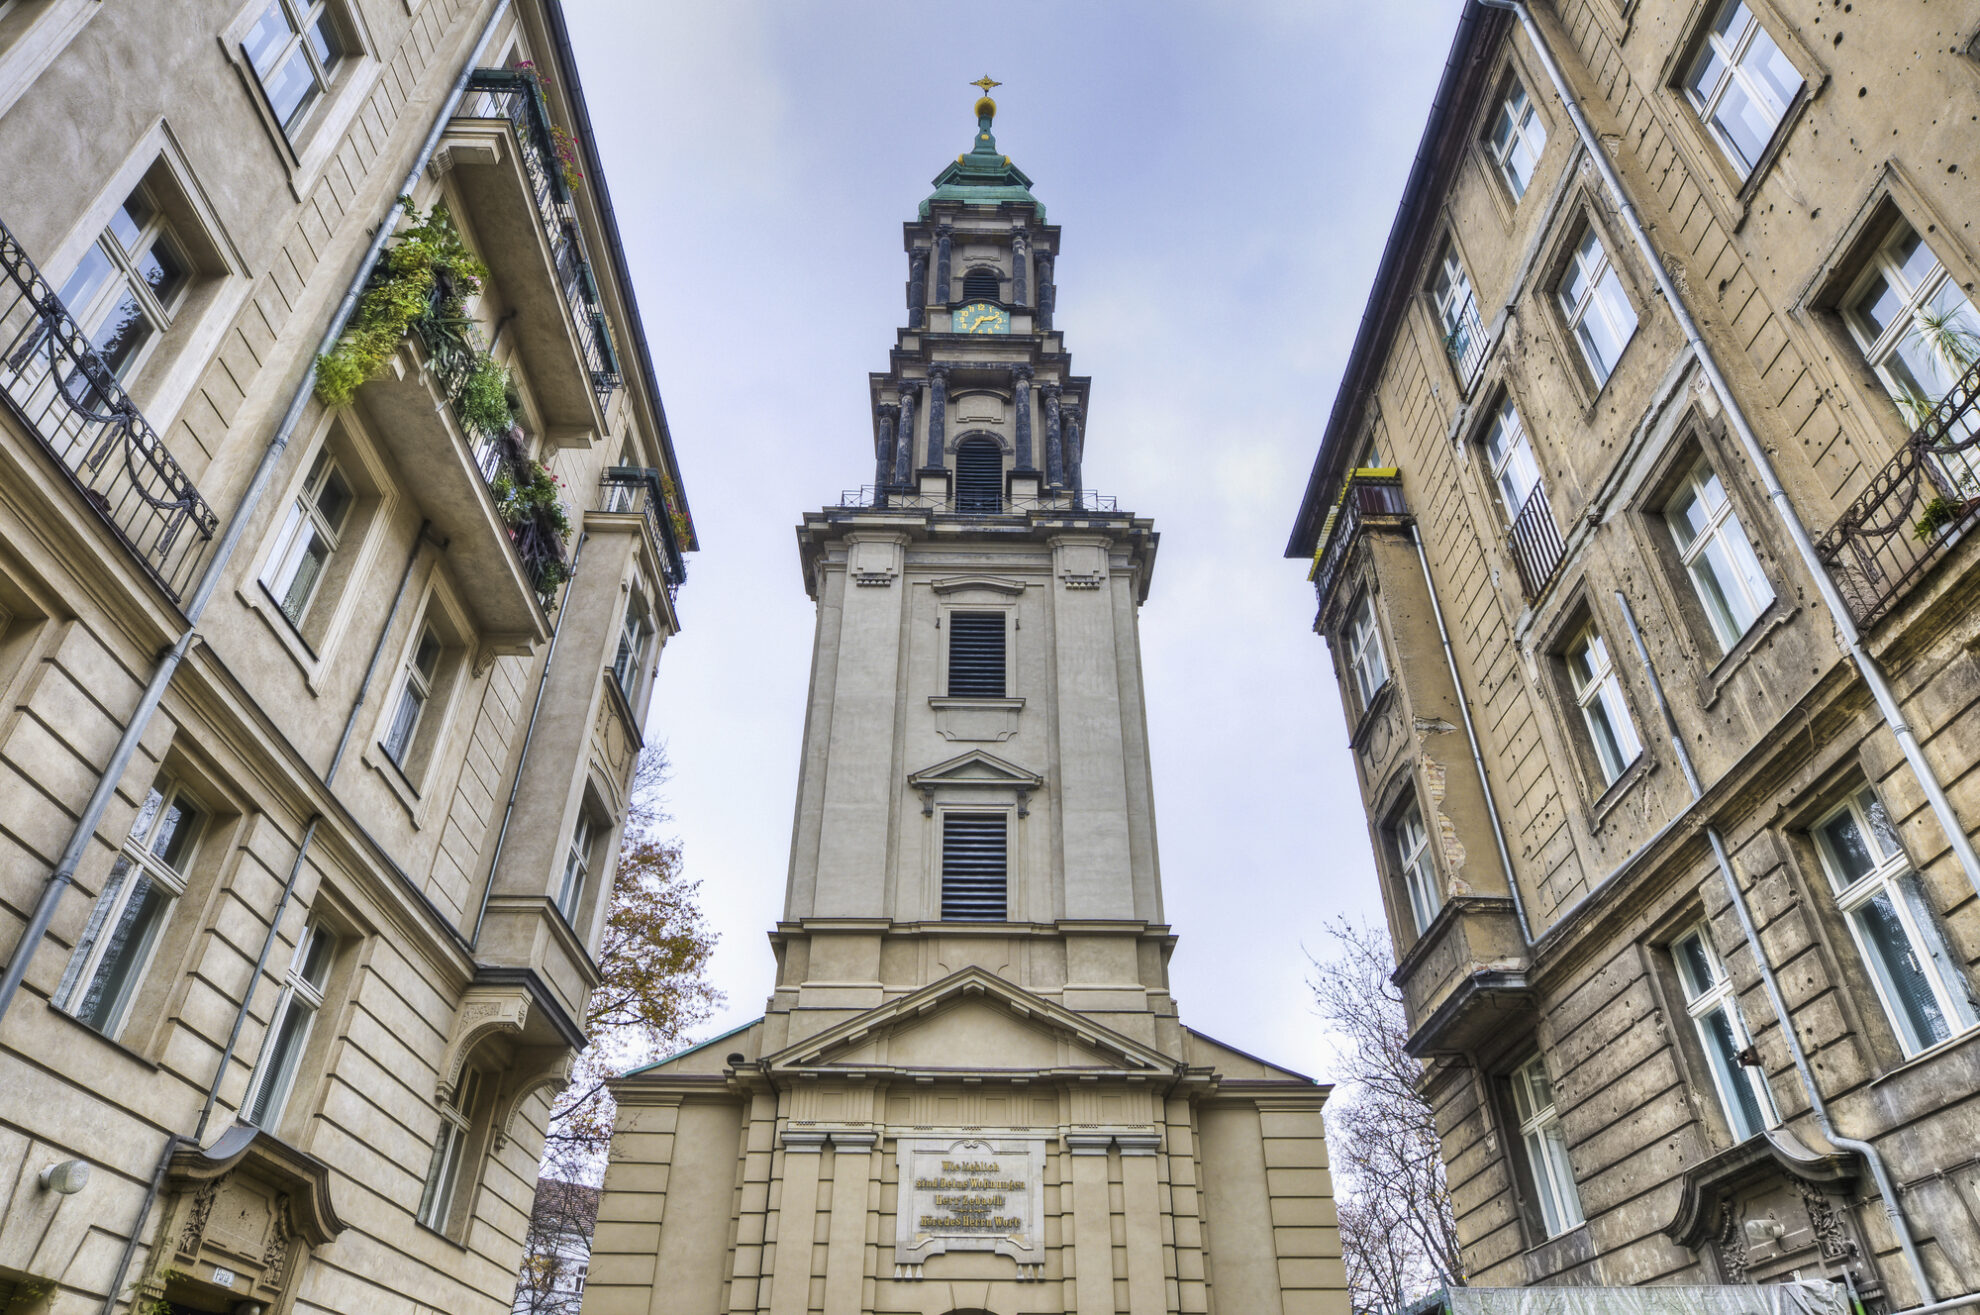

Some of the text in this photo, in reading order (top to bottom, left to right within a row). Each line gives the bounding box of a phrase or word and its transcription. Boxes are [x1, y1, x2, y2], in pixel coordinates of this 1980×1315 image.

[942, 1160, 1000, 1172] Wie lieblich
[916, 1177, 1025, 1191] sind Deine Wohnungen
[936, 1195, 960, 1206] Herr
[920, 1215, 943, 1226] Höre
[944, 1216, 961, 1226] des
[962, 1216, 992, 1227] Herrn
